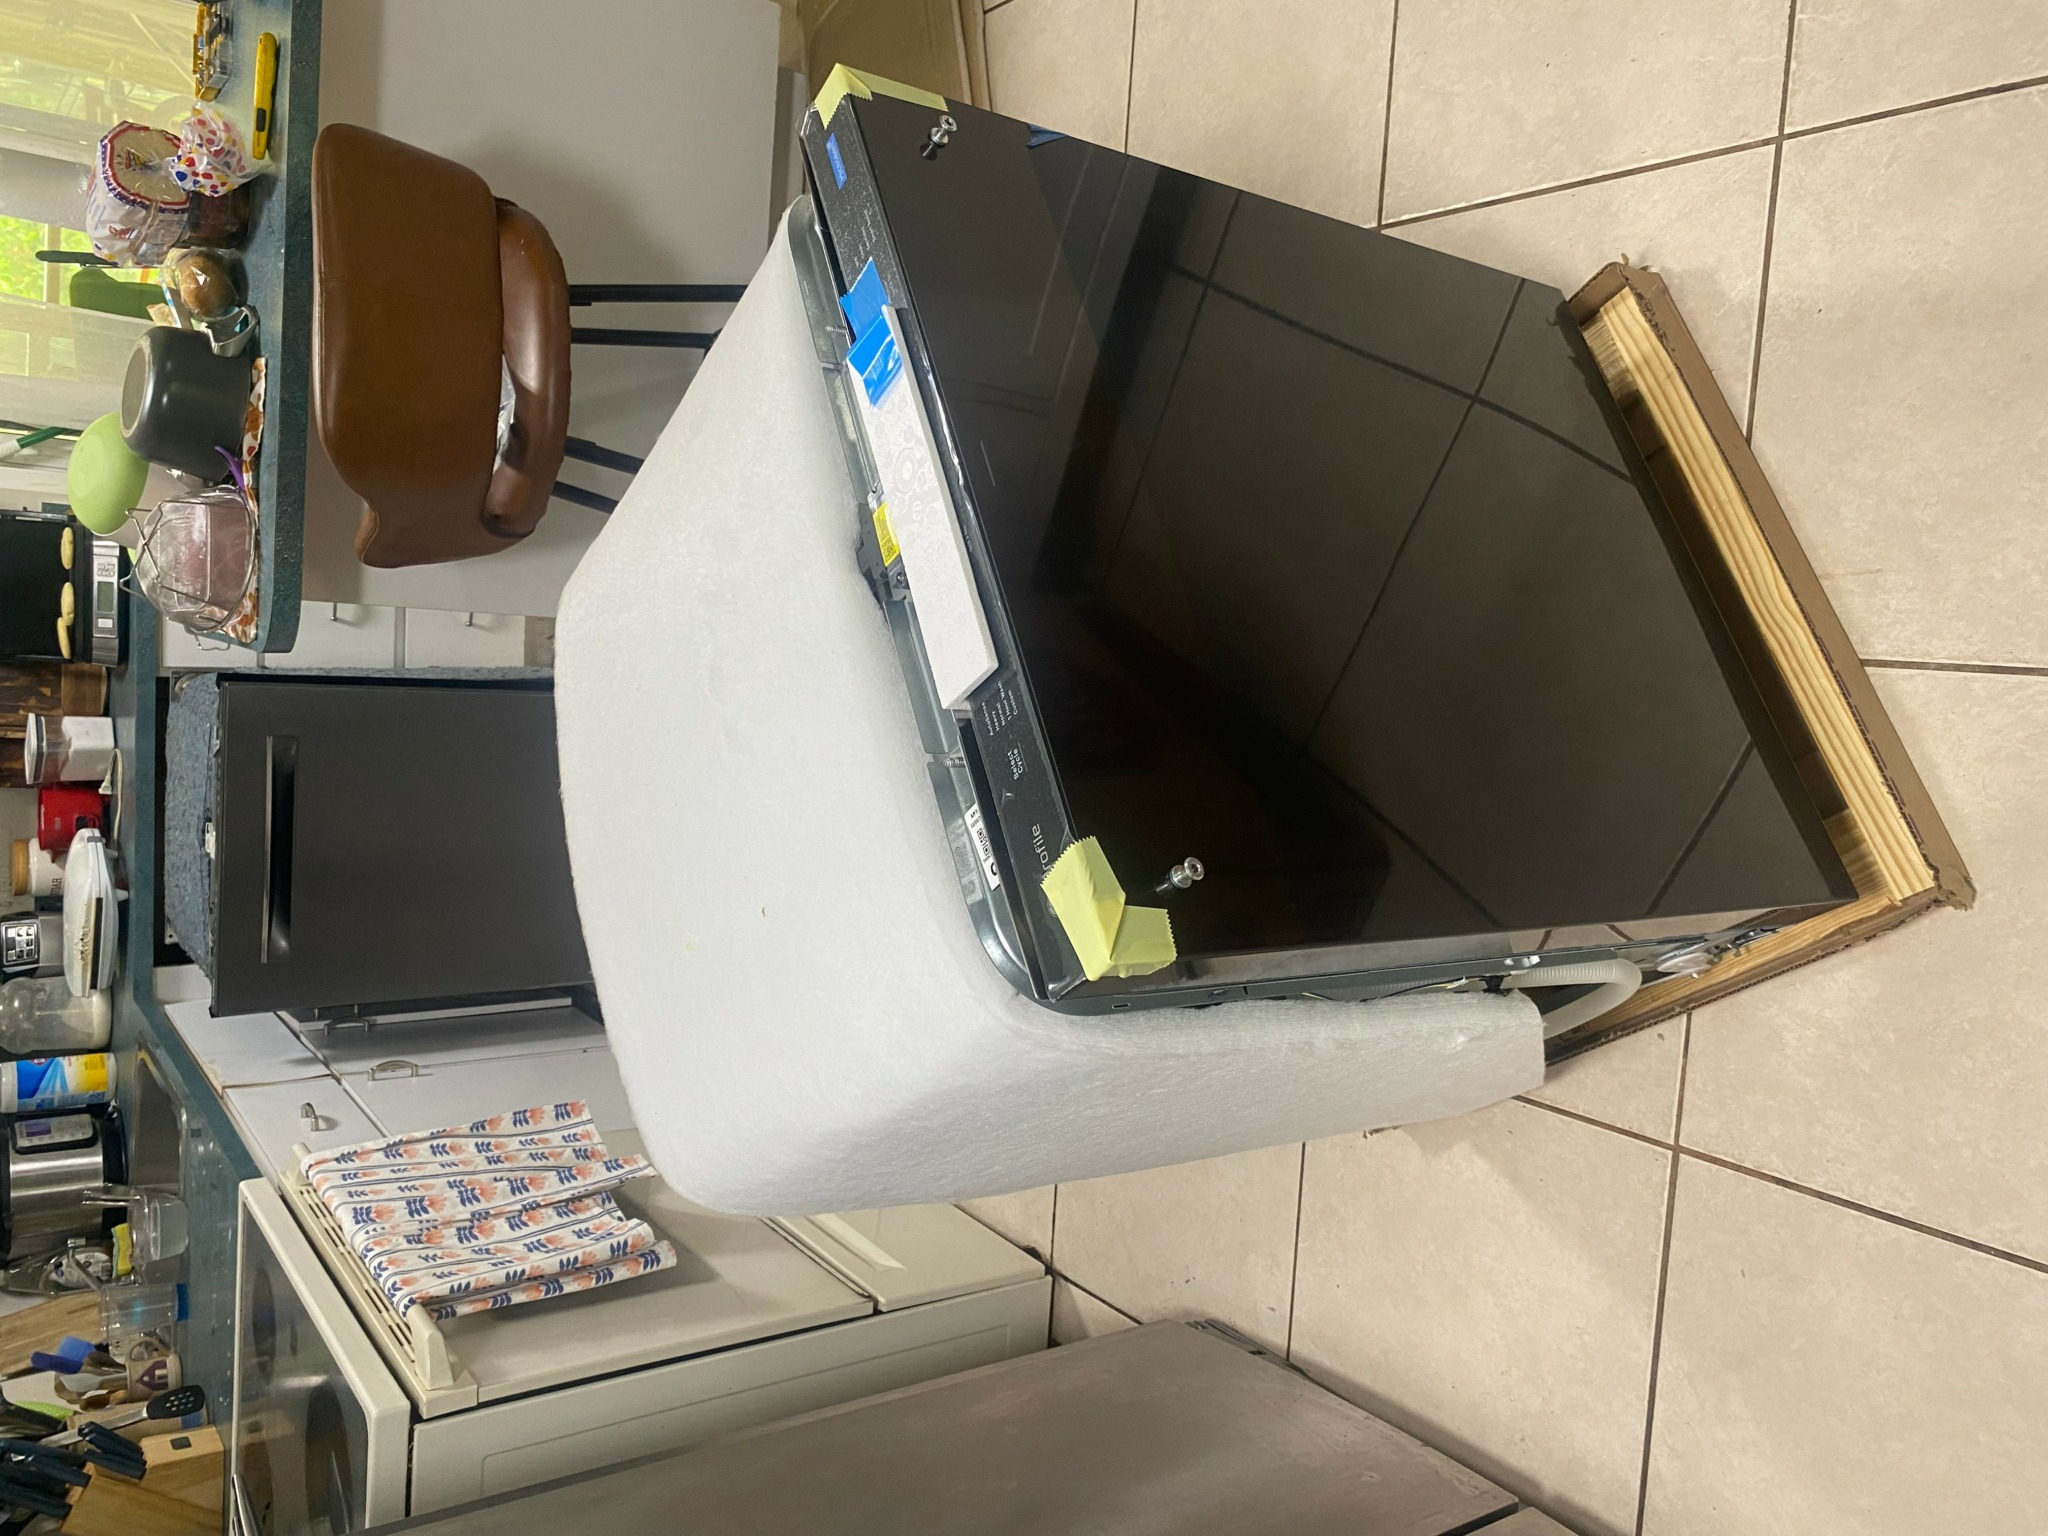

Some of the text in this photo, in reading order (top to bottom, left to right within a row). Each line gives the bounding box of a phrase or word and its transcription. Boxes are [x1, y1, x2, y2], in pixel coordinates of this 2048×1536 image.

[997, 680, 1005, 700] Wash
[1008, 690, 1018, 715] Custom
[981, 702, 994, 736] AutoSense
[996, 702, 1006, 726] Normal
[1003, 700, 1011, 716] Hour
[991, 710, 1000, 732] Heavy
[1006, 749, 1020, 780] Select
[1012, 748, 1024, 774] Cycle
[1030, 823, 1051, 873] rofile
